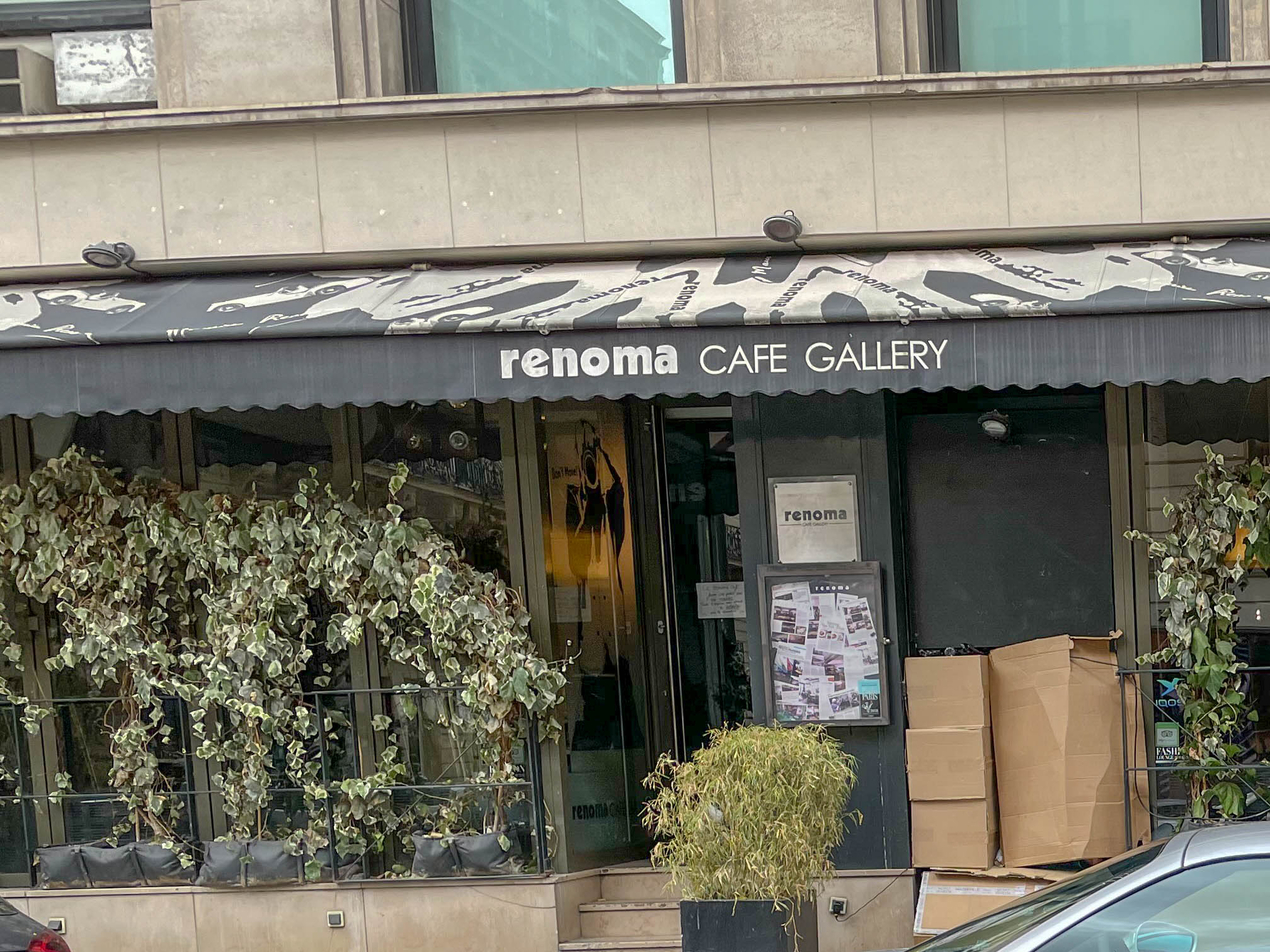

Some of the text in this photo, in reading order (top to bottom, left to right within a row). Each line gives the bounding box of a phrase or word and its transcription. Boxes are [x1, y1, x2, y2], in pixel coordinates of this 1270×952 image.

[583, 275, 662, 303] renoma
[843, 270, 897, 294] renoma
[501, 340, 948, 379] renoma CAFE GALLERY
[784, 509, 847, 522] renoma
